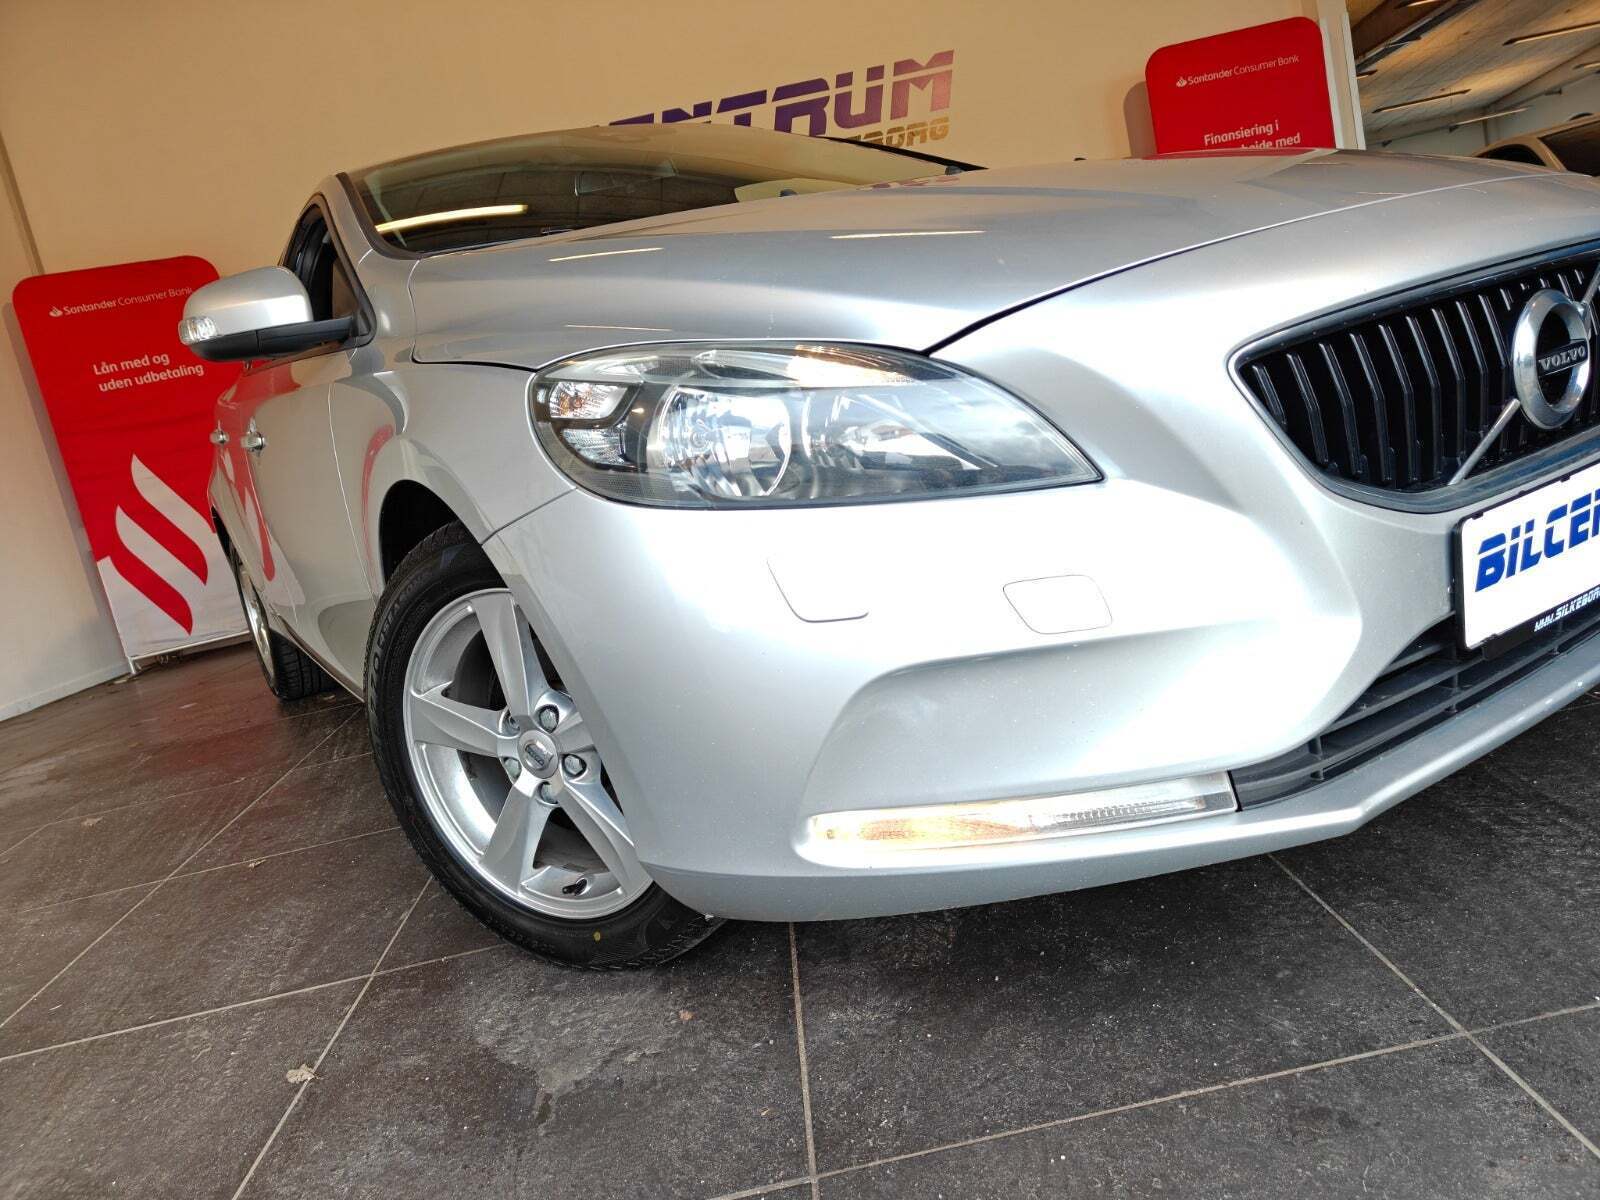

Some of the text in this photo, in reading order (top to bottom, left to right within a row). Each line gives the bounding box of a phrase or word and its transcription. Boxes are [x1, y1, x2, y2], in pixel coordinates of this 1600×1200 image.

[1187, 54, 1299, 85] Santander Consumer Bank
[1204, 119, 1279, 146] Finansiering i
[1275, 132, 1301, 149] med
[63, 286, 193, 316] Santander Consumer Bank
[93, 353, 170, 376] Lån med og
[1538, 345, 1586, 371] VOLVO
[98, 364, 205, 393] uden udbetaling
